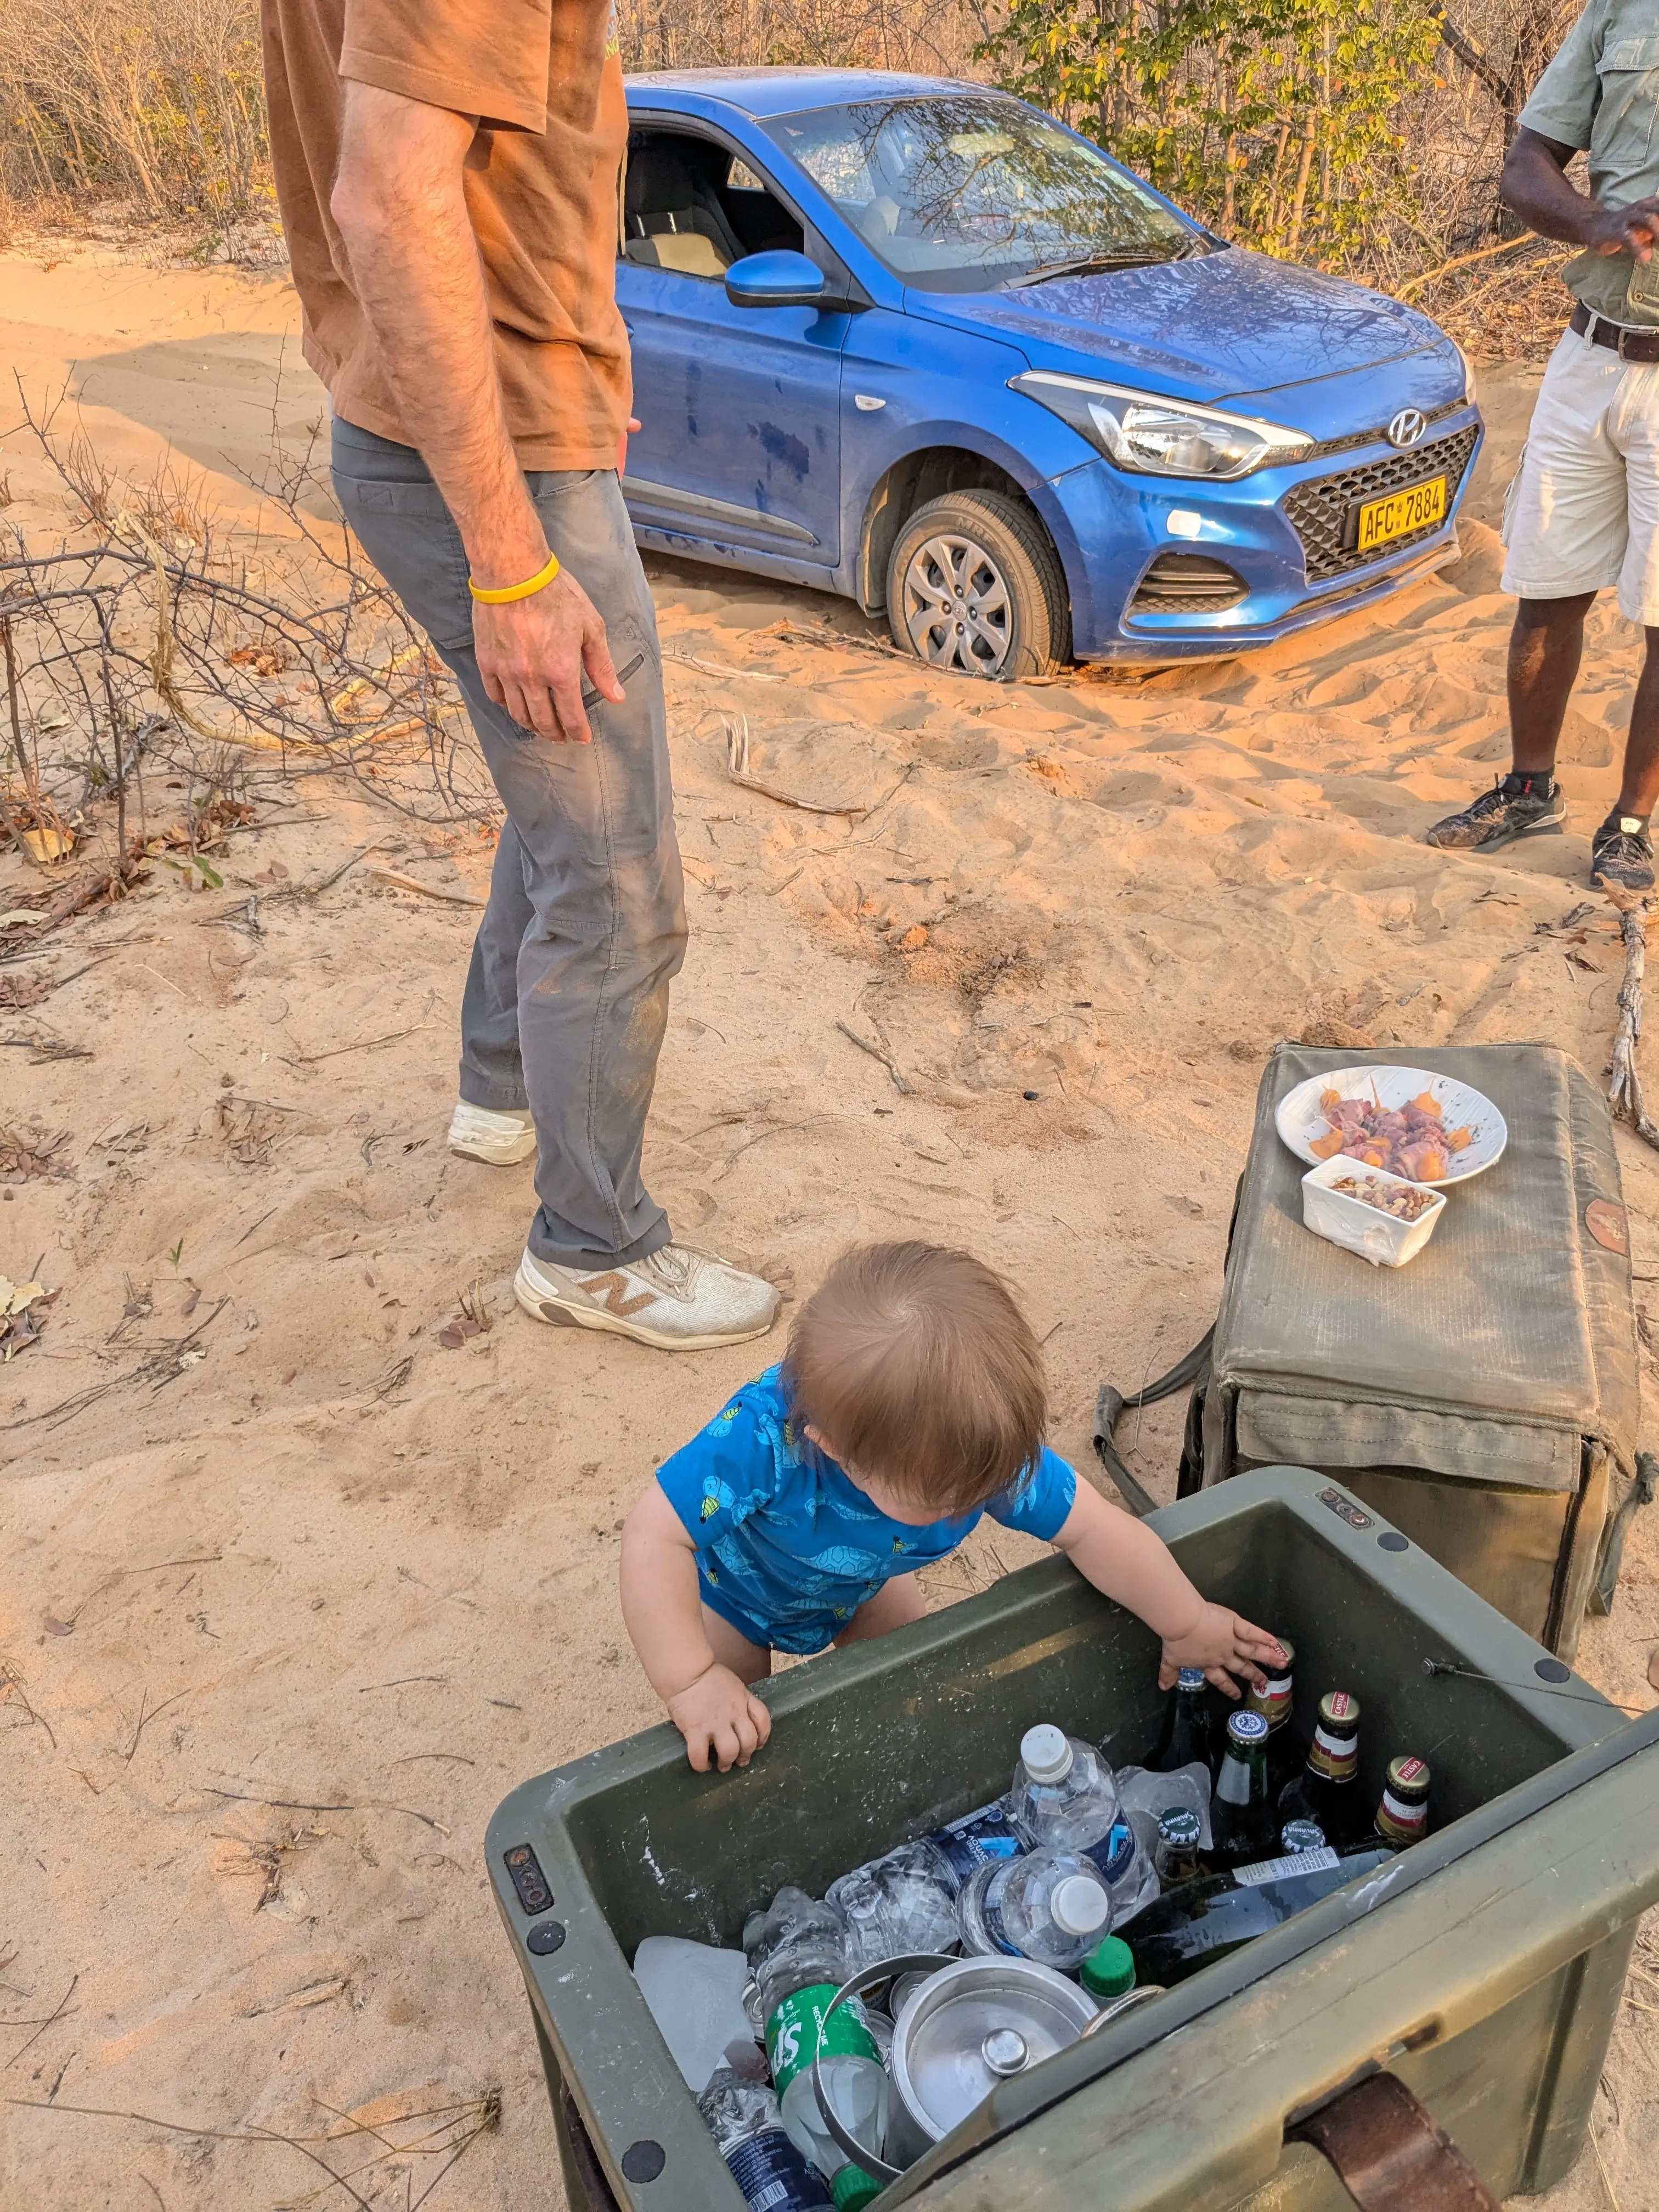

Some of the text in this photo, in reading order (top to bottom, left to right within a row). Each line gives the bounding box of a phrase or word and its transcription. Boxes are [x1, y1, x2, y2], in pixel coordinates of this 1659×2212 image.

[1364, 484, 1439, 543] AFC 7884
[1334, 1694, 1345, 1714] CASTLE
[1401, 1760, 1420, 1778] CASTLE
[1164, 1810, 1194, 1826] Savanna
[1288, 1826, 1320, 1837] Savanna
[967, 1835, 989, 1862] AQUAC
[820, 2034, 829, 2046] ME
